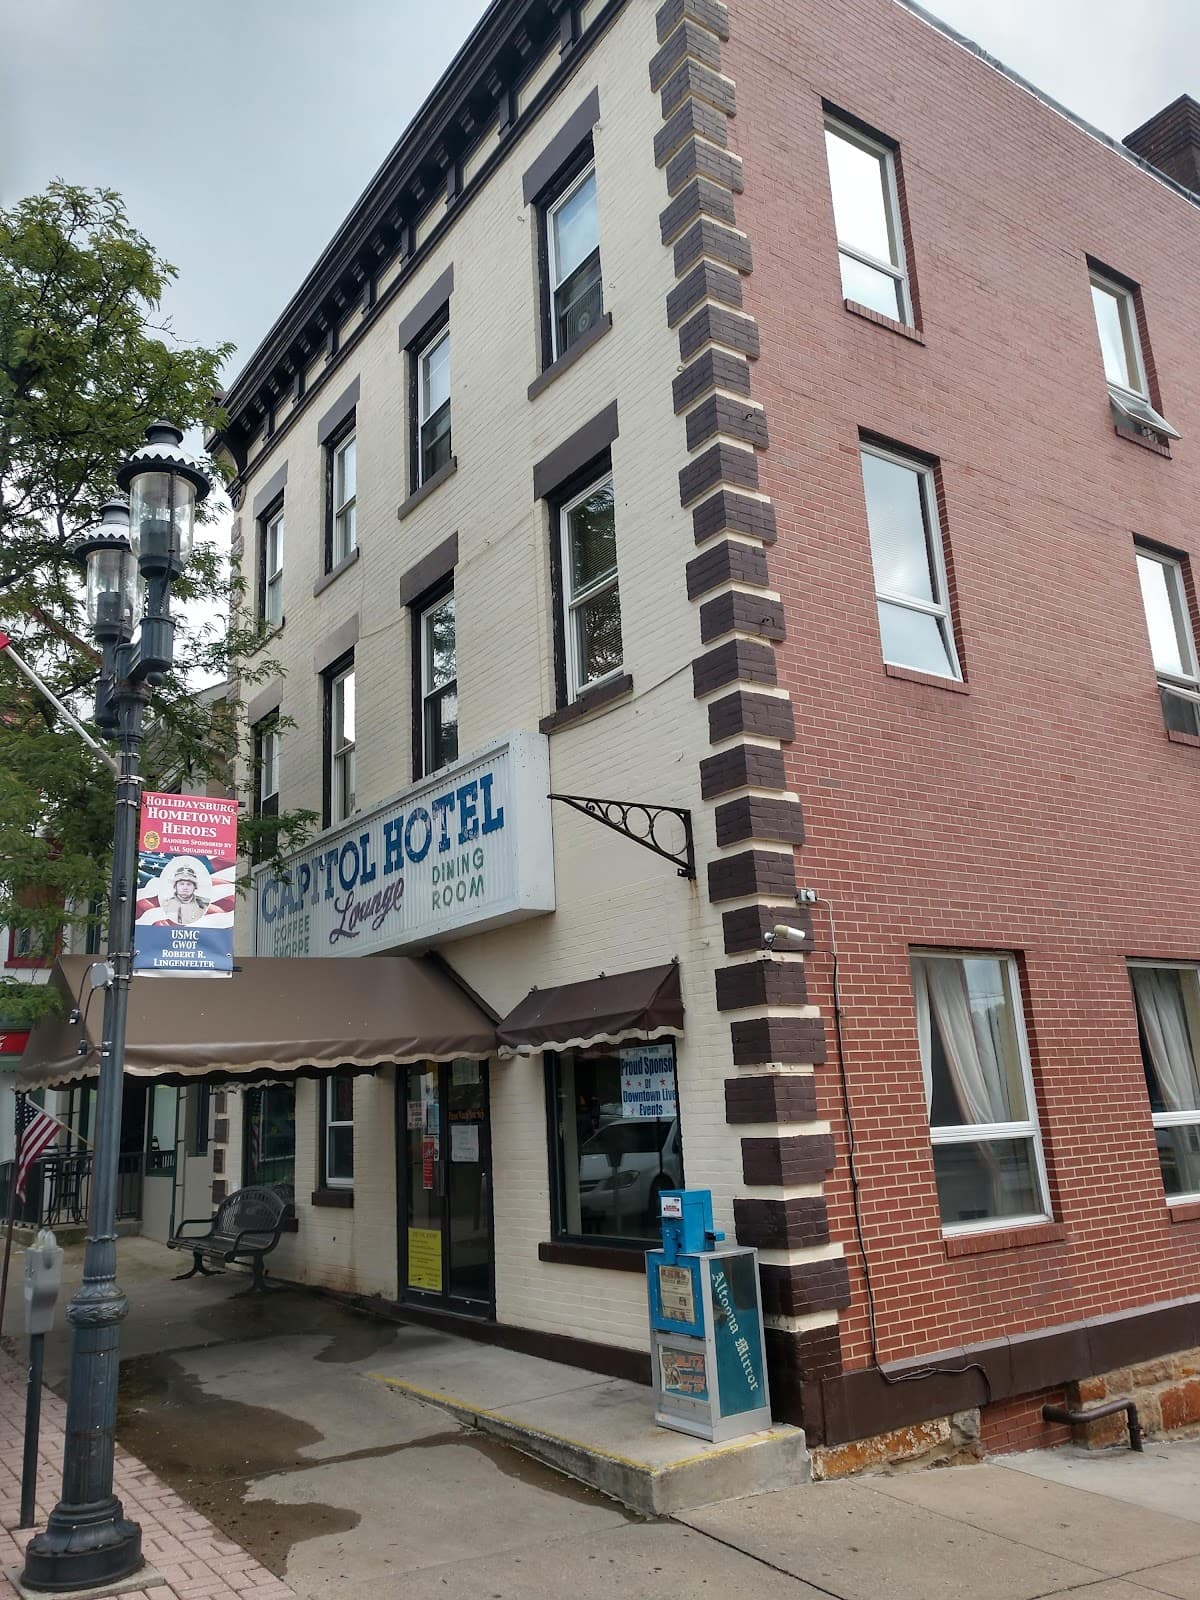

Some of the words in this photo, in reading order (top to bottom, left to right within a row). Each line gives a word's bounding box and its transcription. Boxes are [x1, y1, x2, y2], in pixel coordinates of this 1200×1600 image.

[146, 795, 235, 813] HOLLIDAYSBURG
[147, 806, 232, 825] HOMETOWN
[162, 821, 217, 838] HEROES
[262, 831, 376, 923] CAPITOL
[383, 773, 505, 876] HOTEL
[432, 848, 485, 886] DINING
[432, 875, 486, 911] ROOM
[329, 877, 405, 945] Lounge
[171, 929, 200, 940] USMC
[274, 914, 311, 942] COFFEE
[162, 949, 196, 959] ROBERT
[197, 950, 207, 959] R.
[172, 940, 197, 950] GWOT
[153, 958, 215, 968] LINGENFELTER
[620, 1056, 643, 1076] Proud
[623, 1090, 661, 1103] Downtown
[662, 1088, 677, 1101] Live
[640, 1104, 663, 1116] Events
[712, 1271, 739, 1335] Altoona
[735, 1337, 759, 1391] Mirror
